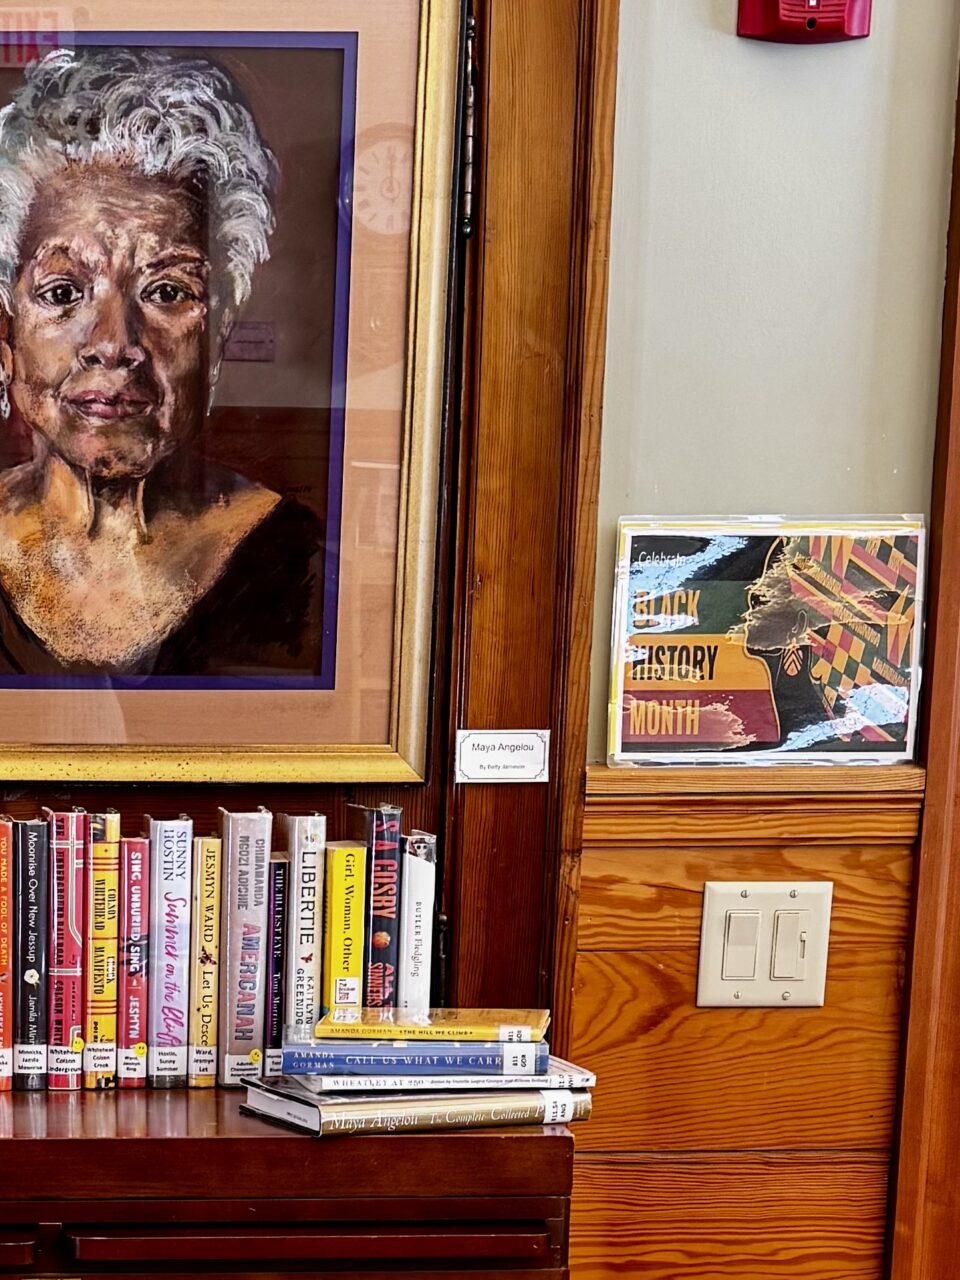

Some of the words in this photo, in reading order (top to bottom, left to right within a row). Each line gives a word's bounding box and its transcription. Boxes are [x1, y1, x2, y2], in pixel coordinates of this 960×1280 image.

[634, 590, 701, 627] BLACK
[631, 645, 718, 682] HISTORY
[629, 699, 700, 737] MONTH
[472, 743, 496, 753] Maya
[498, 743, 534, 753] Angelou
[28, 831, 38, 876] Moonrise
[163, 829, 175, 882] HOSTIN
[175, 830, 187, 881] SUNNY
[238, 836, 250, 867] NGOZI
[344, 853, 356, 881] Girl,
[28, 880, 38, 902] Over
[205, 848, 216, 899] JESMYN
[237, 869, 249, 911] ADICHIE
[254, 838, 265, 907] CHIMAMANDA
[371, 859, 398, 920] COSBY
[95, 879, 106, 931] WHITEHEAD
[107, 888, 117, 920] COLSON
[299, 851, 317, 945] LIBERTIE
[342, 885, 355, 934] Woman,
[0, 924, 7, 934] OF
[28, 906, 38, 928] New
[204, 904, 215, 943] WARD
[413, 901, 422, 936] BUTLER
[0, 937, 8, 966] DEATH
[26, 931, 38, 962] Jessup
[342, 938, 354, 973] Other
[94, 946, 105, 995] MANIFESTO
[202, 971, 213, 989] Let
[234, 923, 262, 1041] AMERICANAH
[367, 962, 384, 1006] SINNERS
[129, 995, 140, 1039] JESMYN
[202, 994, 213, 1009] Us
[304, 976, 314, 1025] KAITLYN
[345, 1056, 377, 1065] CALL
[382, 1056, 398, 1065] US
[403, 1056, 439, 1065] WHAT
[445, 1056, 464, 1065] WE
[469, 1055, 502, 1066] CARR
[329, 1112, 366, 1134] Maya
[370, 1111, 419, 1131] Angelou
[445, 1109, 486, 1126] Complete
[491, 1107, 530, 1122] Collected
